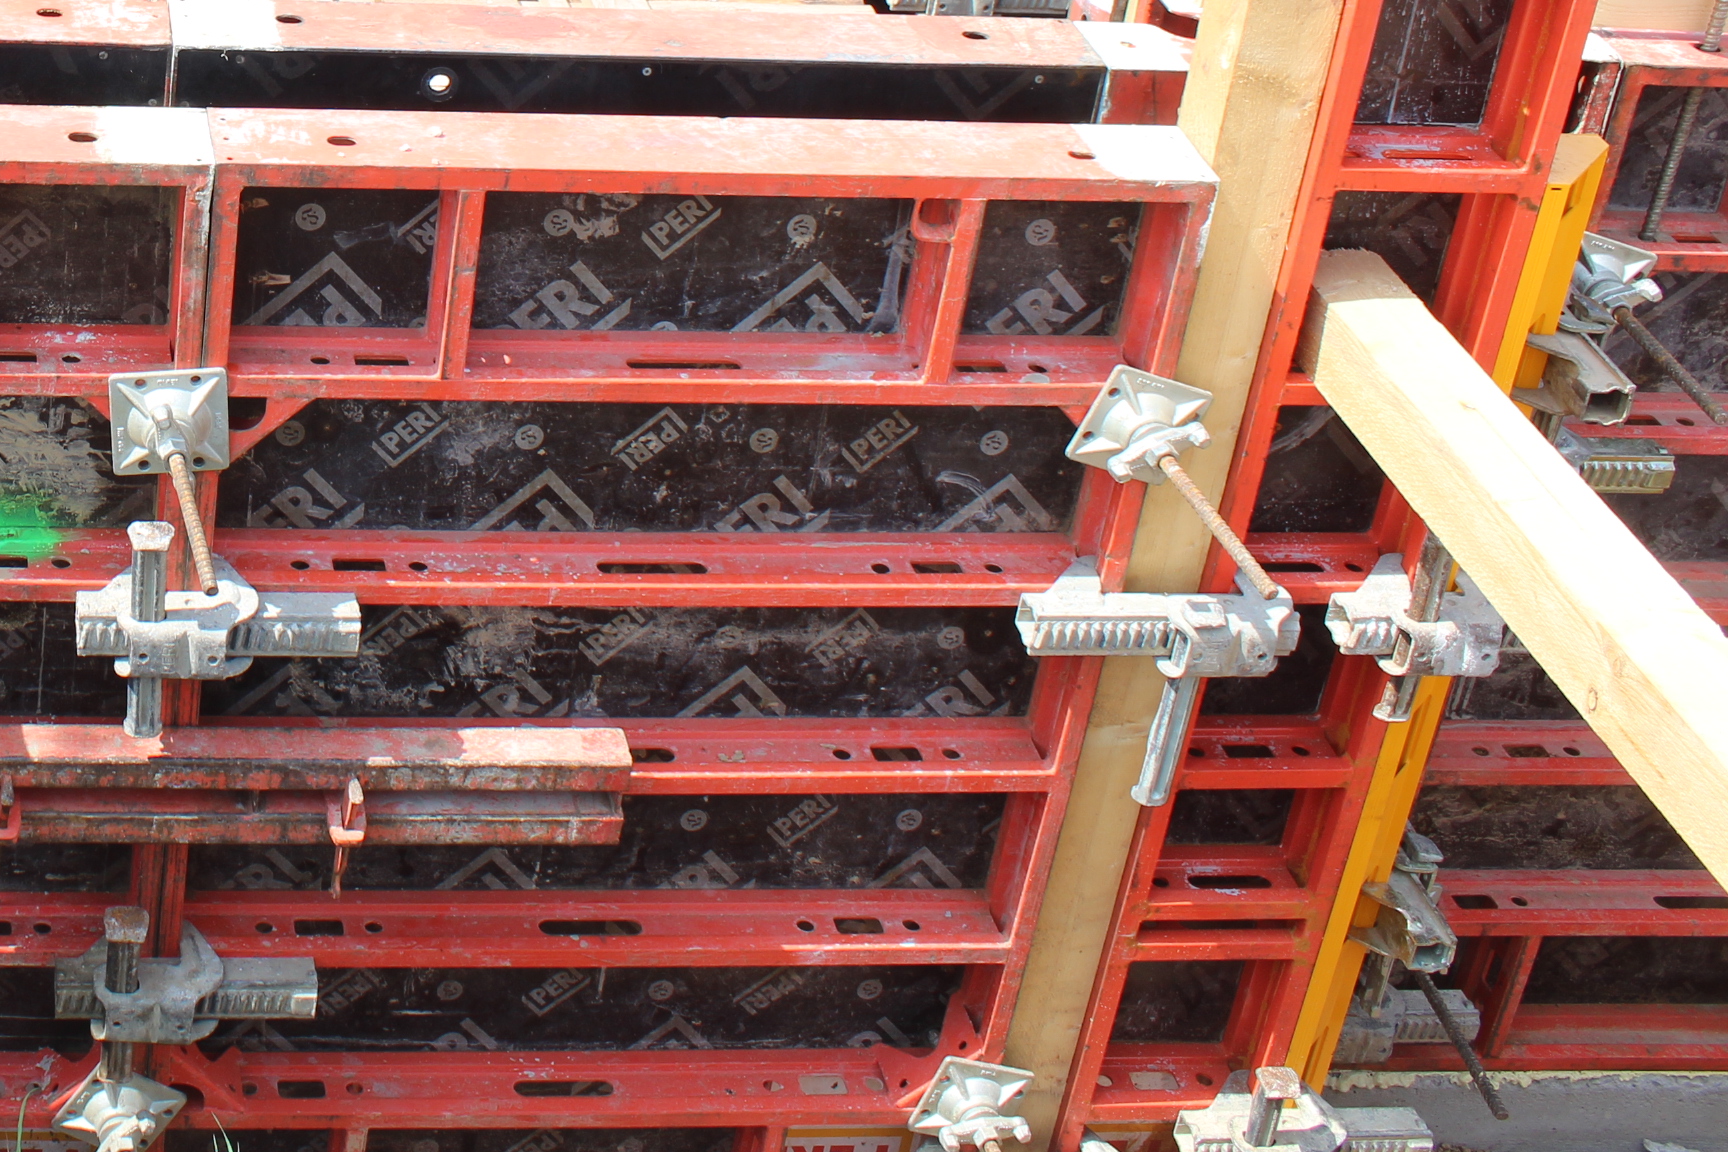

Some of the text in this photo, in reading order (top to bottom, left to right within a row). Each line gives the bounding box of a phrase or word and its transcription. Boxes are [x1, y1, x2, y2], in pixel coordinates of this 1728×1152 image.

[662, 194, 716, 246] PERI
[379, 402, 442, 456] PERI
[618, 419, 682, 471] PERI
[860, 410, 913, 461] PERI
